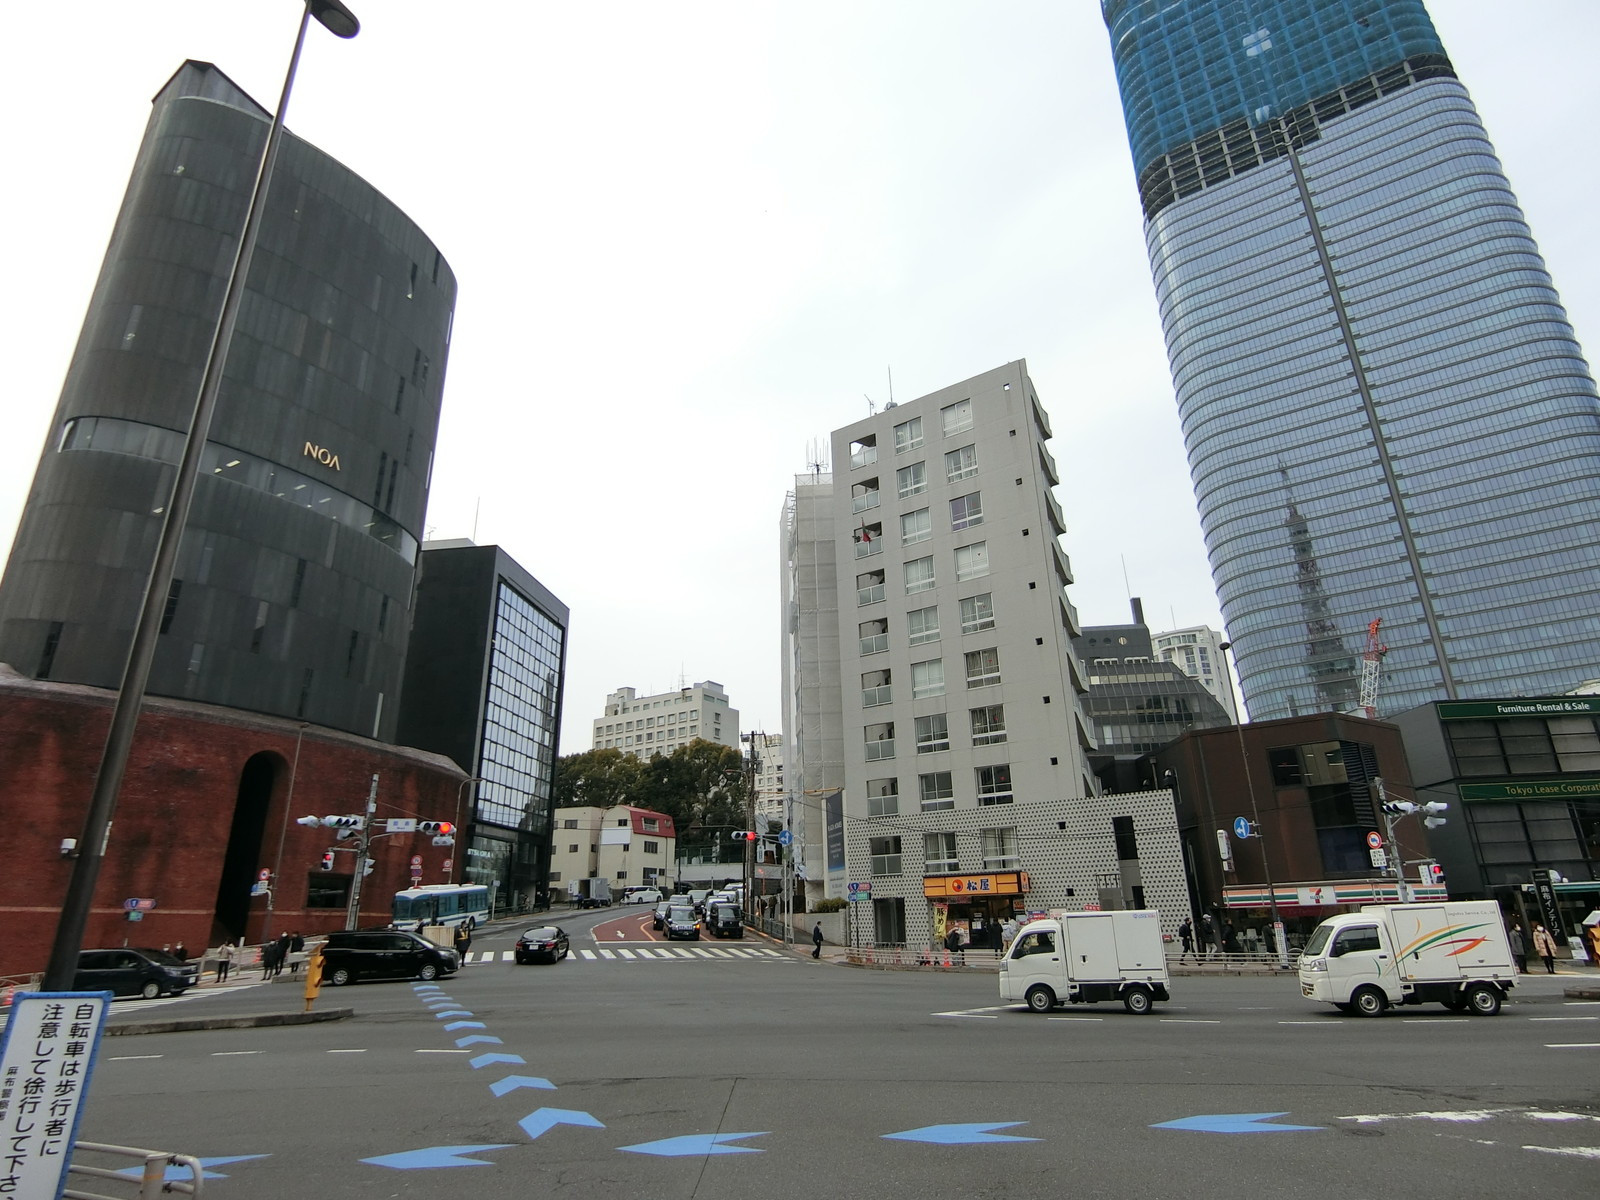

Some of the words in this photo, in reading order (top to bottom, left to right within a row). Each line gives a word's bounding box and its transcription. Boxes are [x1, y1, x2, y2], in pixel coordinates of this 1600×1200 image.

[304, 441, 340, 471] NOA
[1497, 704, 1536, 713] Furniture
[1536, 703, 1563, 712] Rental
[1572, 702, 1590, 710] Sale
[1505, 786, 1533, 796] Tokyo
[967, 878, 990, 891] 松屋
[1540, 885, 1560, 936] 麻布インテリア
[40, 1003, 94, 1157] 自転車は歩行者に
